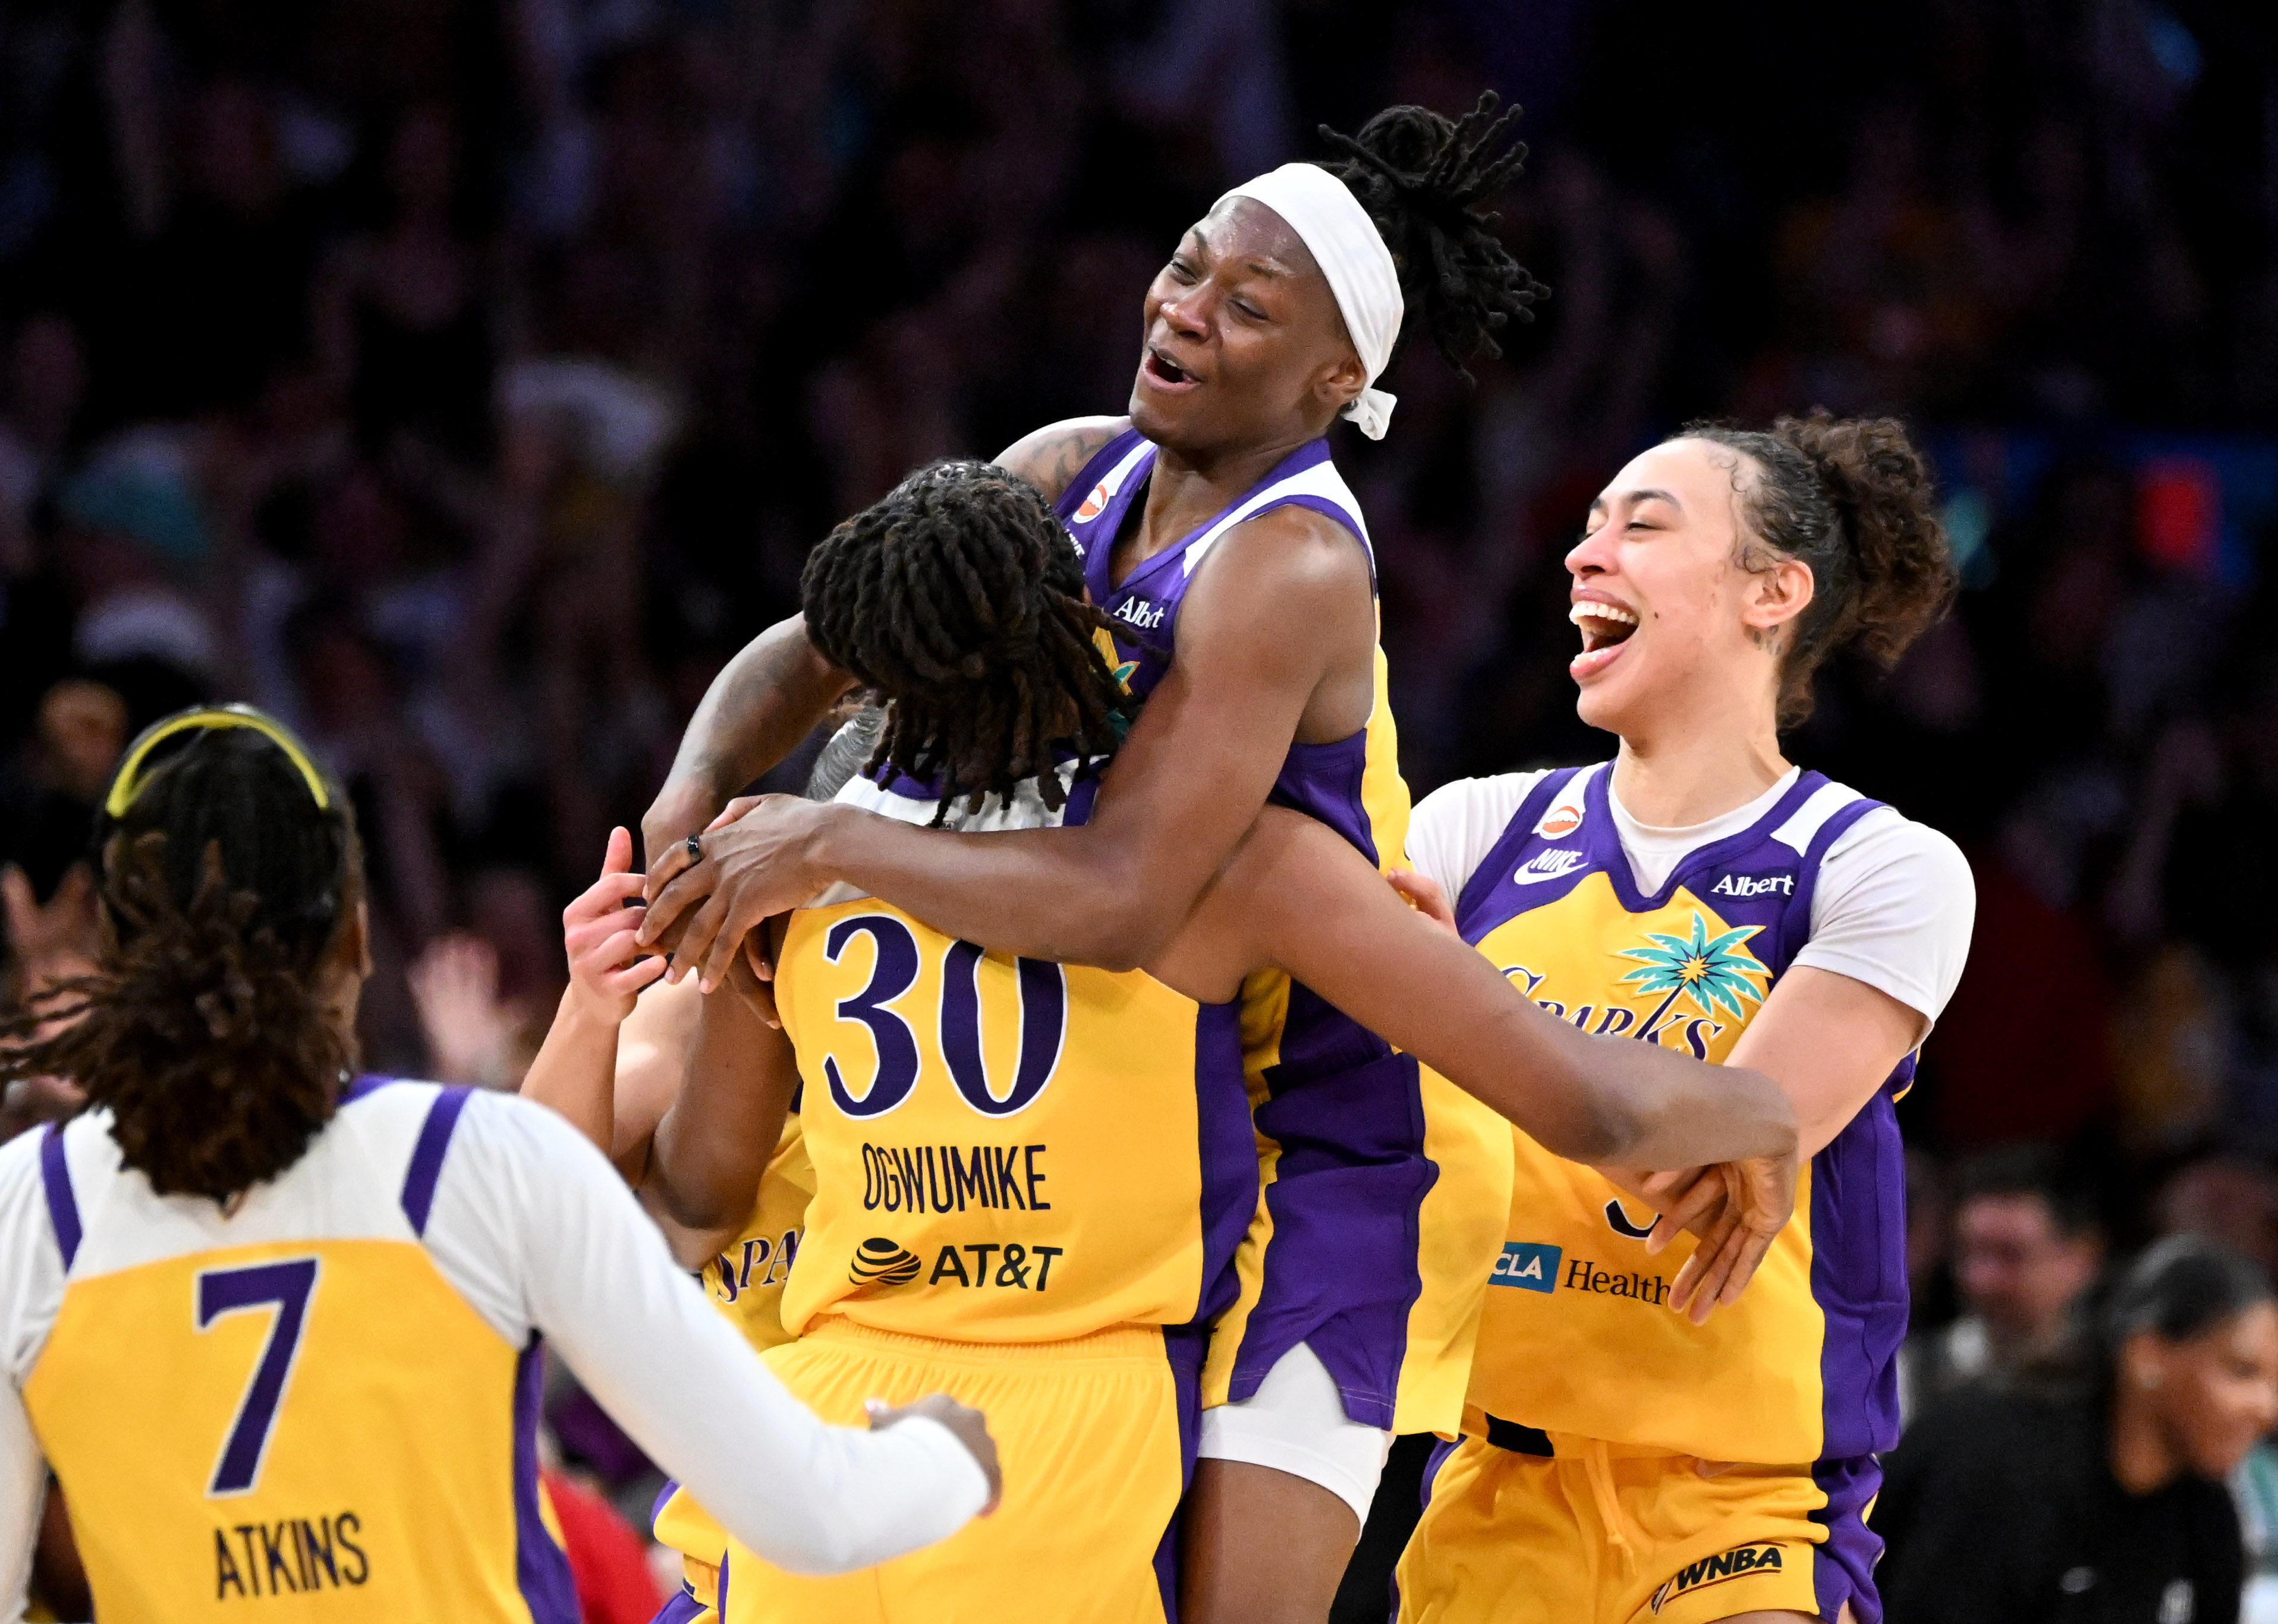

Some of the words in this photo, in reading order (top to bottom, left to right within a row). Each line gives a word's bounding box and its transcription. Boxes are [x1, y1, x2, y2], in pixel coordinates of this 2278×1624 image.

[1113, 595, 1165, 629] Albt
[1530, 848, 1582, 872] NIKE
[1710, 874, 1794, 896] Albert
[822, 912, 1068, 1121] 30
[861, 1142, 1051, 1214] OGWUMIKE
[715, 1227, 806, 1304] SPA
[928, 1243, 1064, 1292] AT&T
[1493, 1252, 1543, 1280] CLA
[1563, 1258, 1671, 1305] Health
[193, 1252, 324, 1500] 7
[213, 1510, 370, 1602] ATKINS
[1677, 1547, 1783, 1591] WNBA
